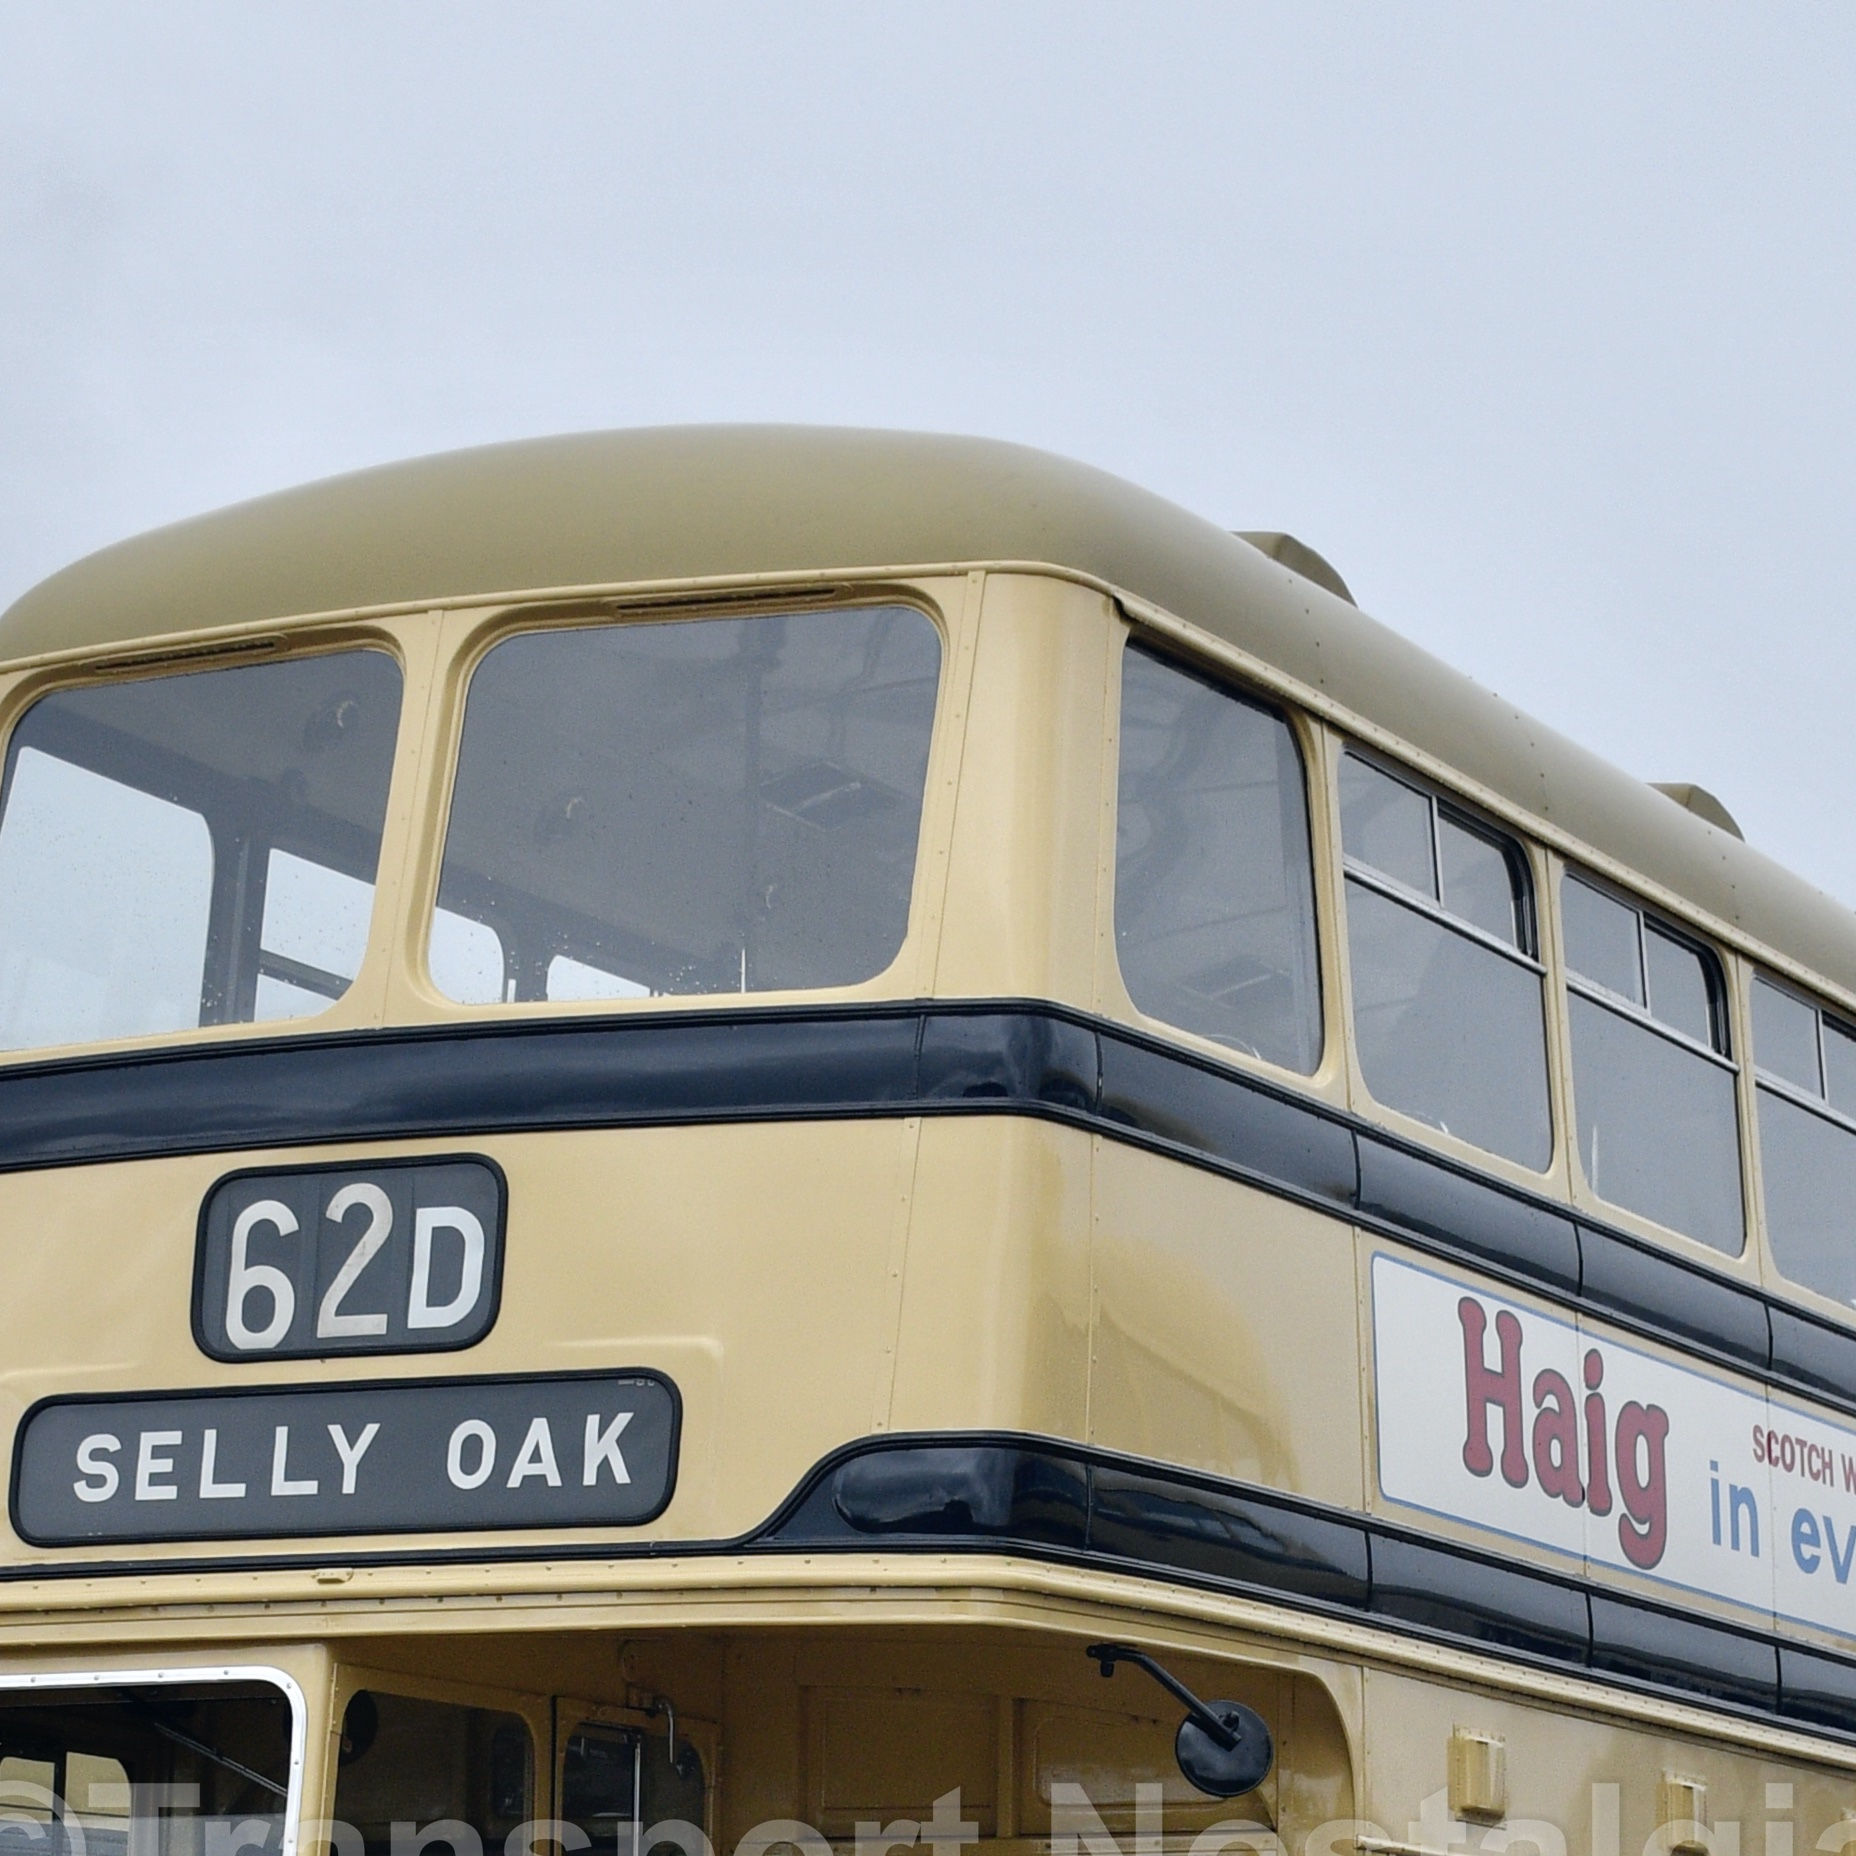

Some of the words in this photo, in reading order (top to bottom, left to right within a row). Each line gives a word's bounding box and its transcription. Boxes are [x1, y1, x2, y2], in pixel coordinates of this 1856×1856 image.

[225, 1182, 485, 1350] 62D
[73, 1423, 381, 1502] SELLY
[447, 1411, 635, 1490] OAK
[1457, 1295, 1670, 1570] Haig
[1753, 1424, 1835, 1487] SCOTCH
[1709, 1459, 1760, 1558] in
